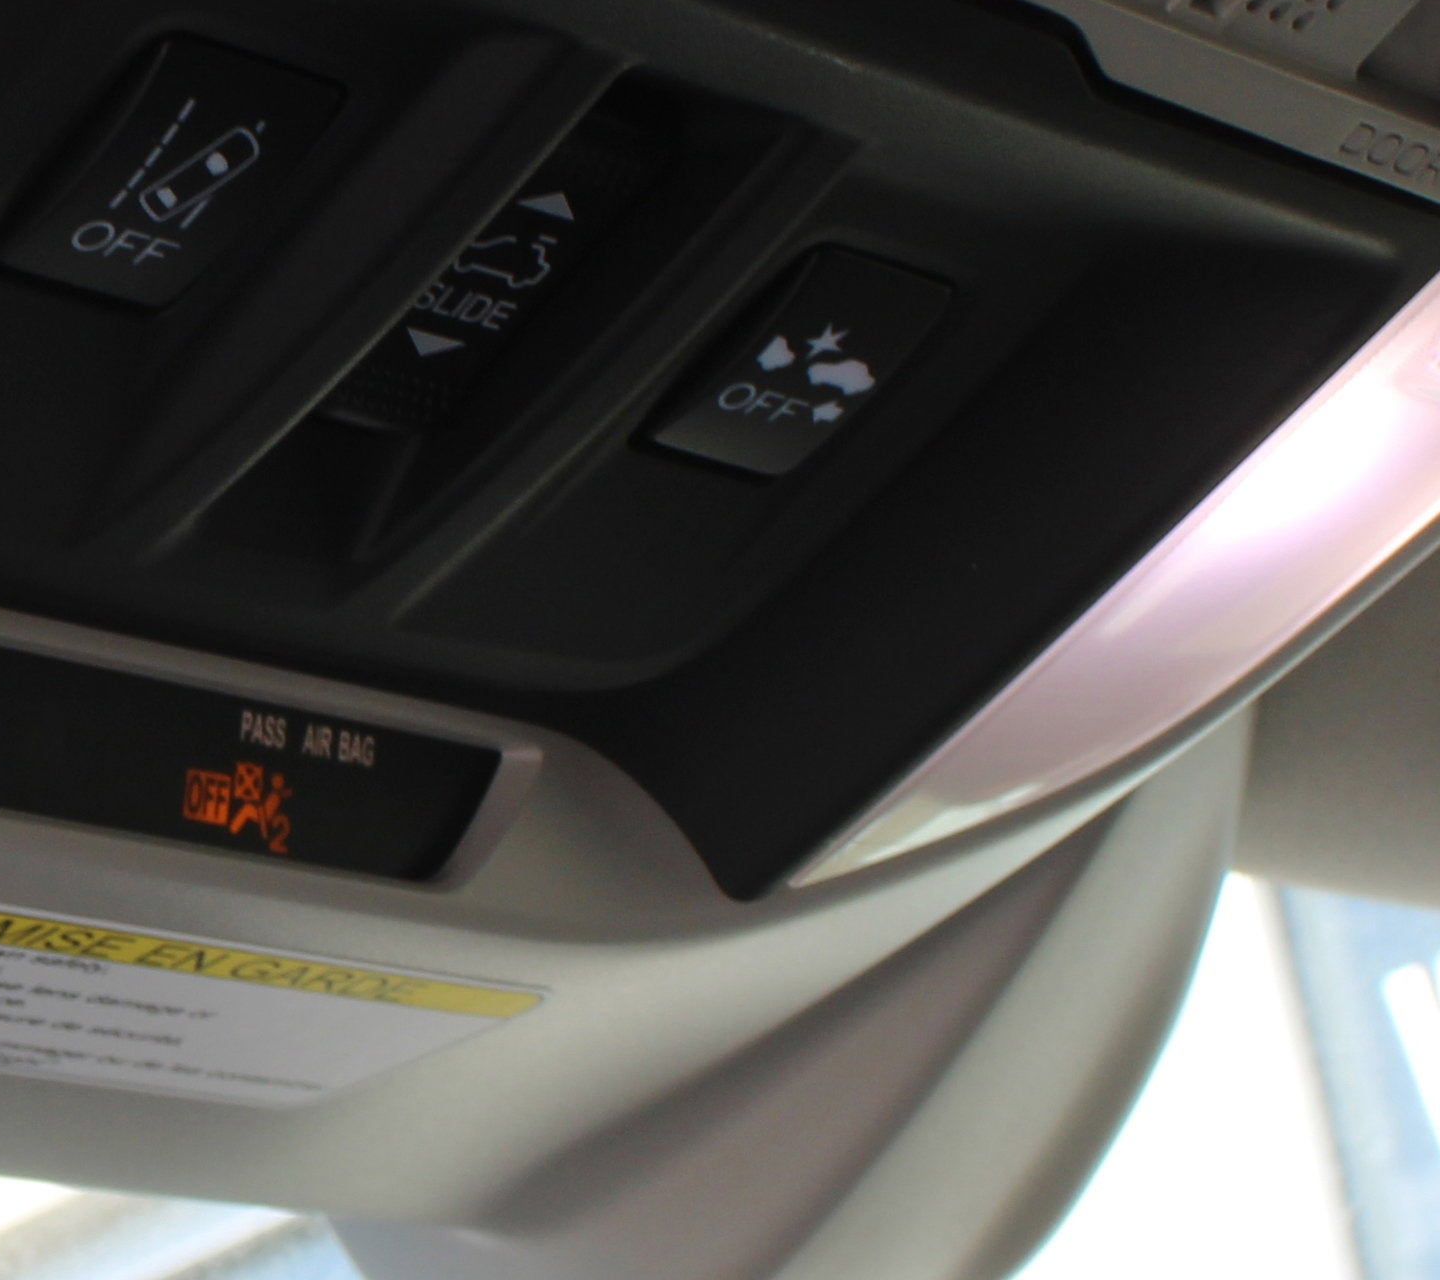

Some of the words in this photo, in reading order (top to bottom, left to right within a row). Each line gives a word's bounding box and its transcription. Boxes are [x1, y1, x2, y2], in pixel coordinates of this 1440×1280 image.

[71, 219, 181, 268] OFF
[411, 280, 518, 331] SLIDE
[717, 381, 809, 425] OFF
[240, 710, 287, 750] PASS
[301, 724, 333, 759] AIR
[338, 731, 376, 767] BAG
[186, 770, 230, 825] OFF
[134, 945, 227, 976] EN
[229, 958, 424, 1003] GARDE
